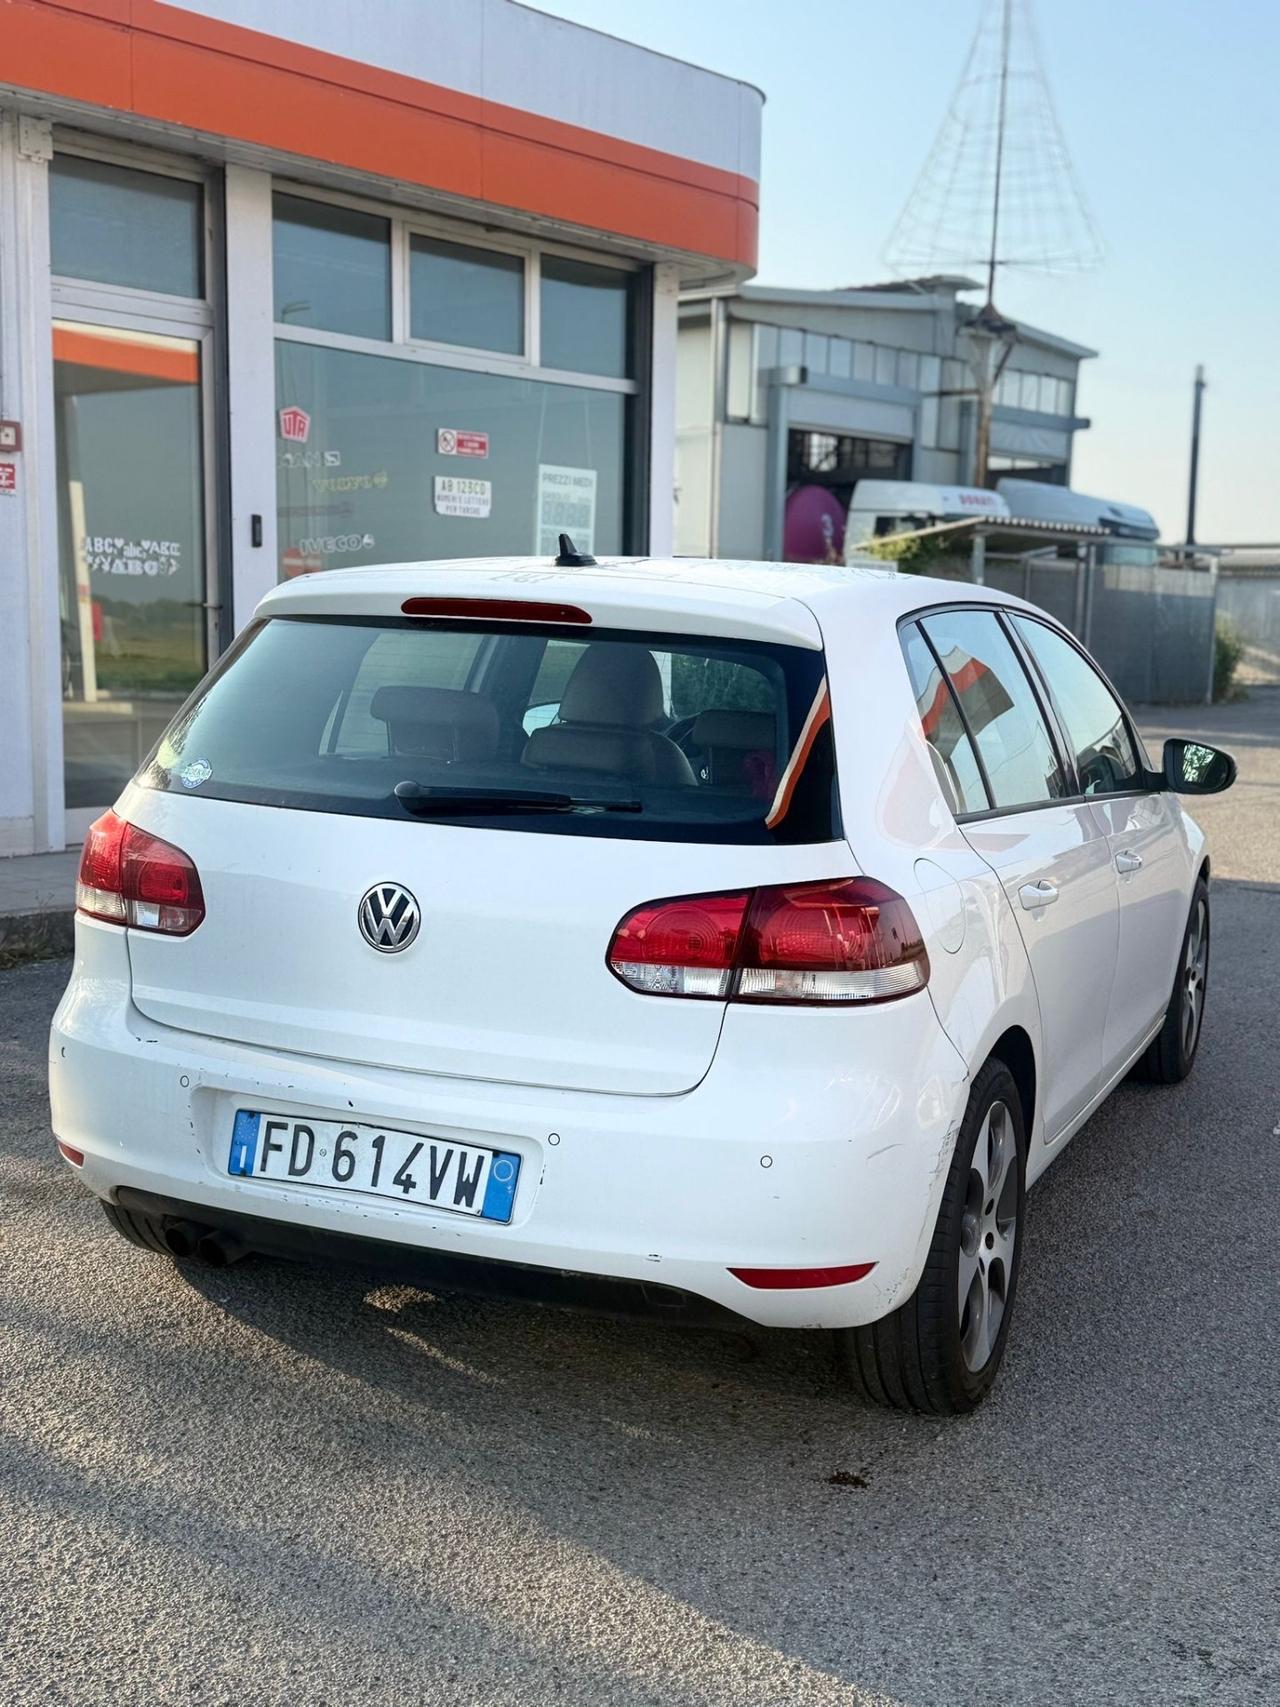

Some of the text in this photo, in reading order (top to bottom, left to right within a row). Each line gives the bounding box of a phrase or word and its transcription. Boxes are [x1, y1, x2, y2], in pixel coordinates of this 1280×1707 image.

[282, 410, 307, 439] UTA
[441, 479, 454, 492] AB
[542, 473, 572, 486] PREZZI
[299, 534, 362, 556] IVECO
[259, 1120, 485, 1209] FD 614VW
